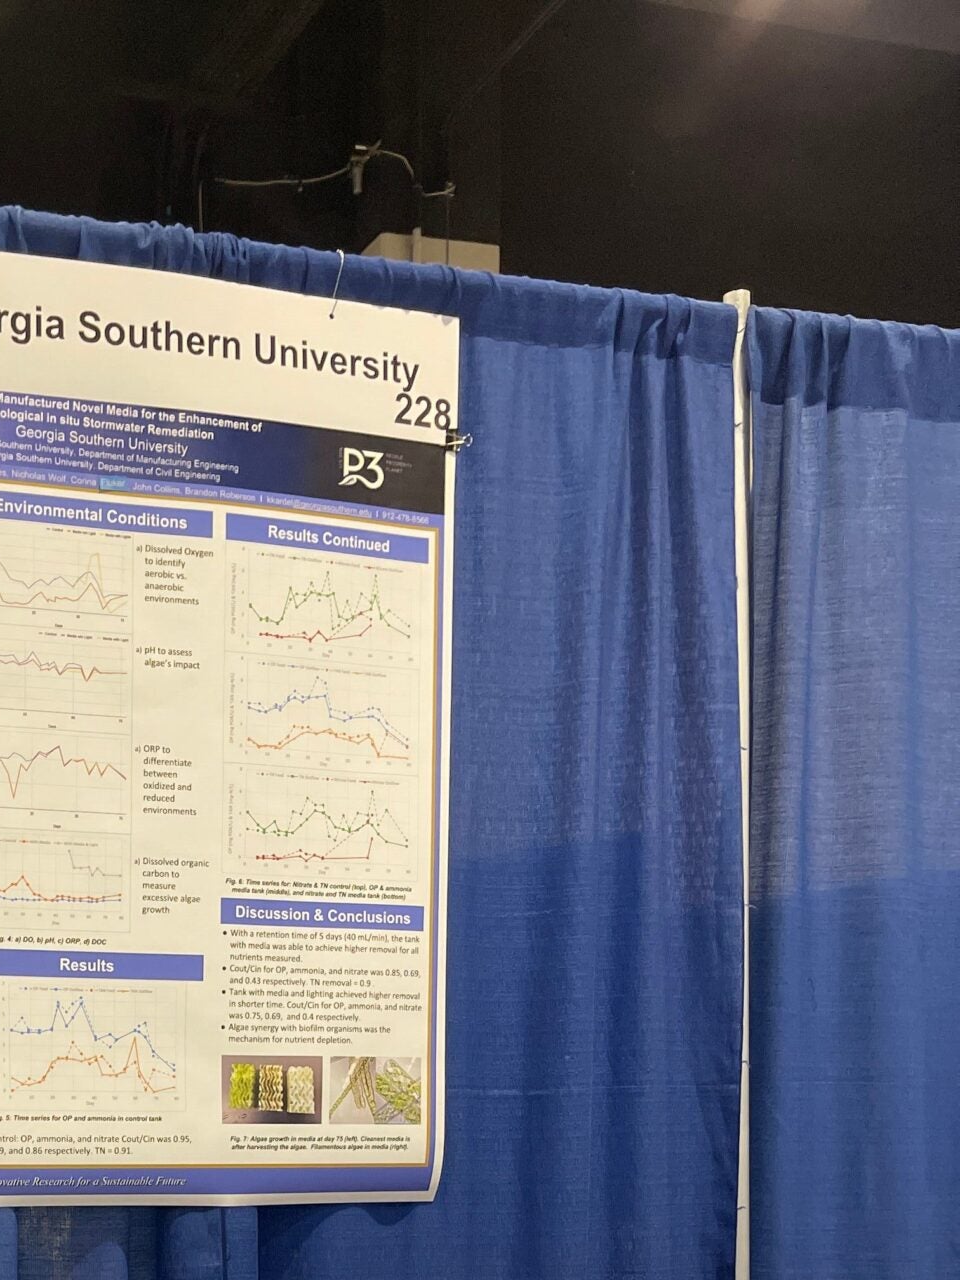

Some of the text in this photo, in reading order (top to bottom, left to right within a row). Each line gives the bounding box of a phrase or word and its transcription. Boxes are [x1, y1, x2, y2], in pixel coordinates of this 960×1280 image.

[78, 311, 240, 360] Southern
[255, 333, 419, 392] University
[72, 400, 103, 414] Novel
[106, 404, 138, 417] Media
[141, 408, 156, 419] for
[158, 411, 175, 422] the
[178, 412, 249, 431] Enhancement
[251, 422, 262, 432] of
[394, 393, 452, 430] 228
[59, 414, 79, 426] situ
[83, 416, 145, 433] Stormwater
[147, 423, 214, 440] Remediation
[16, 424, 188, 457] Georgia Southern University
[15, 452, 52, 464] Southern
[97, 461, 143, 474] Department
[145, 466, 153, 475] of
[155, 467, 172, 476] Civil
[174, 468, 220, 483] Engineering
[78, 447, 124, 461] Department
[126, 453, 134, 462] of
[136, 454, 191, 469] Manufacturing
[194, 459, 239, 474] Engineering
[107, 509, 187, 529] Conditions
[268, 525, 389, 552] Results Continued
[145, 544, 182, 554] Dissolved
[184, 547, 213, 558] Oxygen
[144, 557, 185, 569] to identify
[144, 570, 174, 579] aerobic
[144, 583, 183, 592] anaerobic
[144, 595, 199, 605] environments
[144, 646, 155, 655] pH
[157, 647, 166, 655] to
[173, 660, 200, 669] impact
[236, 905, 410, 924] Discussion & Conclusions
[60, 958, 114, 972] Results
[228, 1023, 249, 1032] Algae
[250, 1025, 279, 1033] synergy
[298, 1024, 324, 1032] biofilm
[326, 1026, 362, 1034] organisms
[228, 1035, 352, 1045] mechanism for nutrient depletion.
[20, 1134, 34, 1143] OP,
[36, 1135, 75, 1144] ammonia,
[121, 1134, 154, 1144] Cout/Cin
[173, 1135, 191, 1144] 0.95,
[8, 1146, 23, 1154] and
[25, 1146, 42, 1154] 0.86
[44, 1147, 93, 1156] respectively.
[32, 1176, 75, 1185] Research
[76, 1176, 91, 1187] for
[101, 1176, 154, 1185] Sustainable
[155, 1176, 186, 1185] Future
